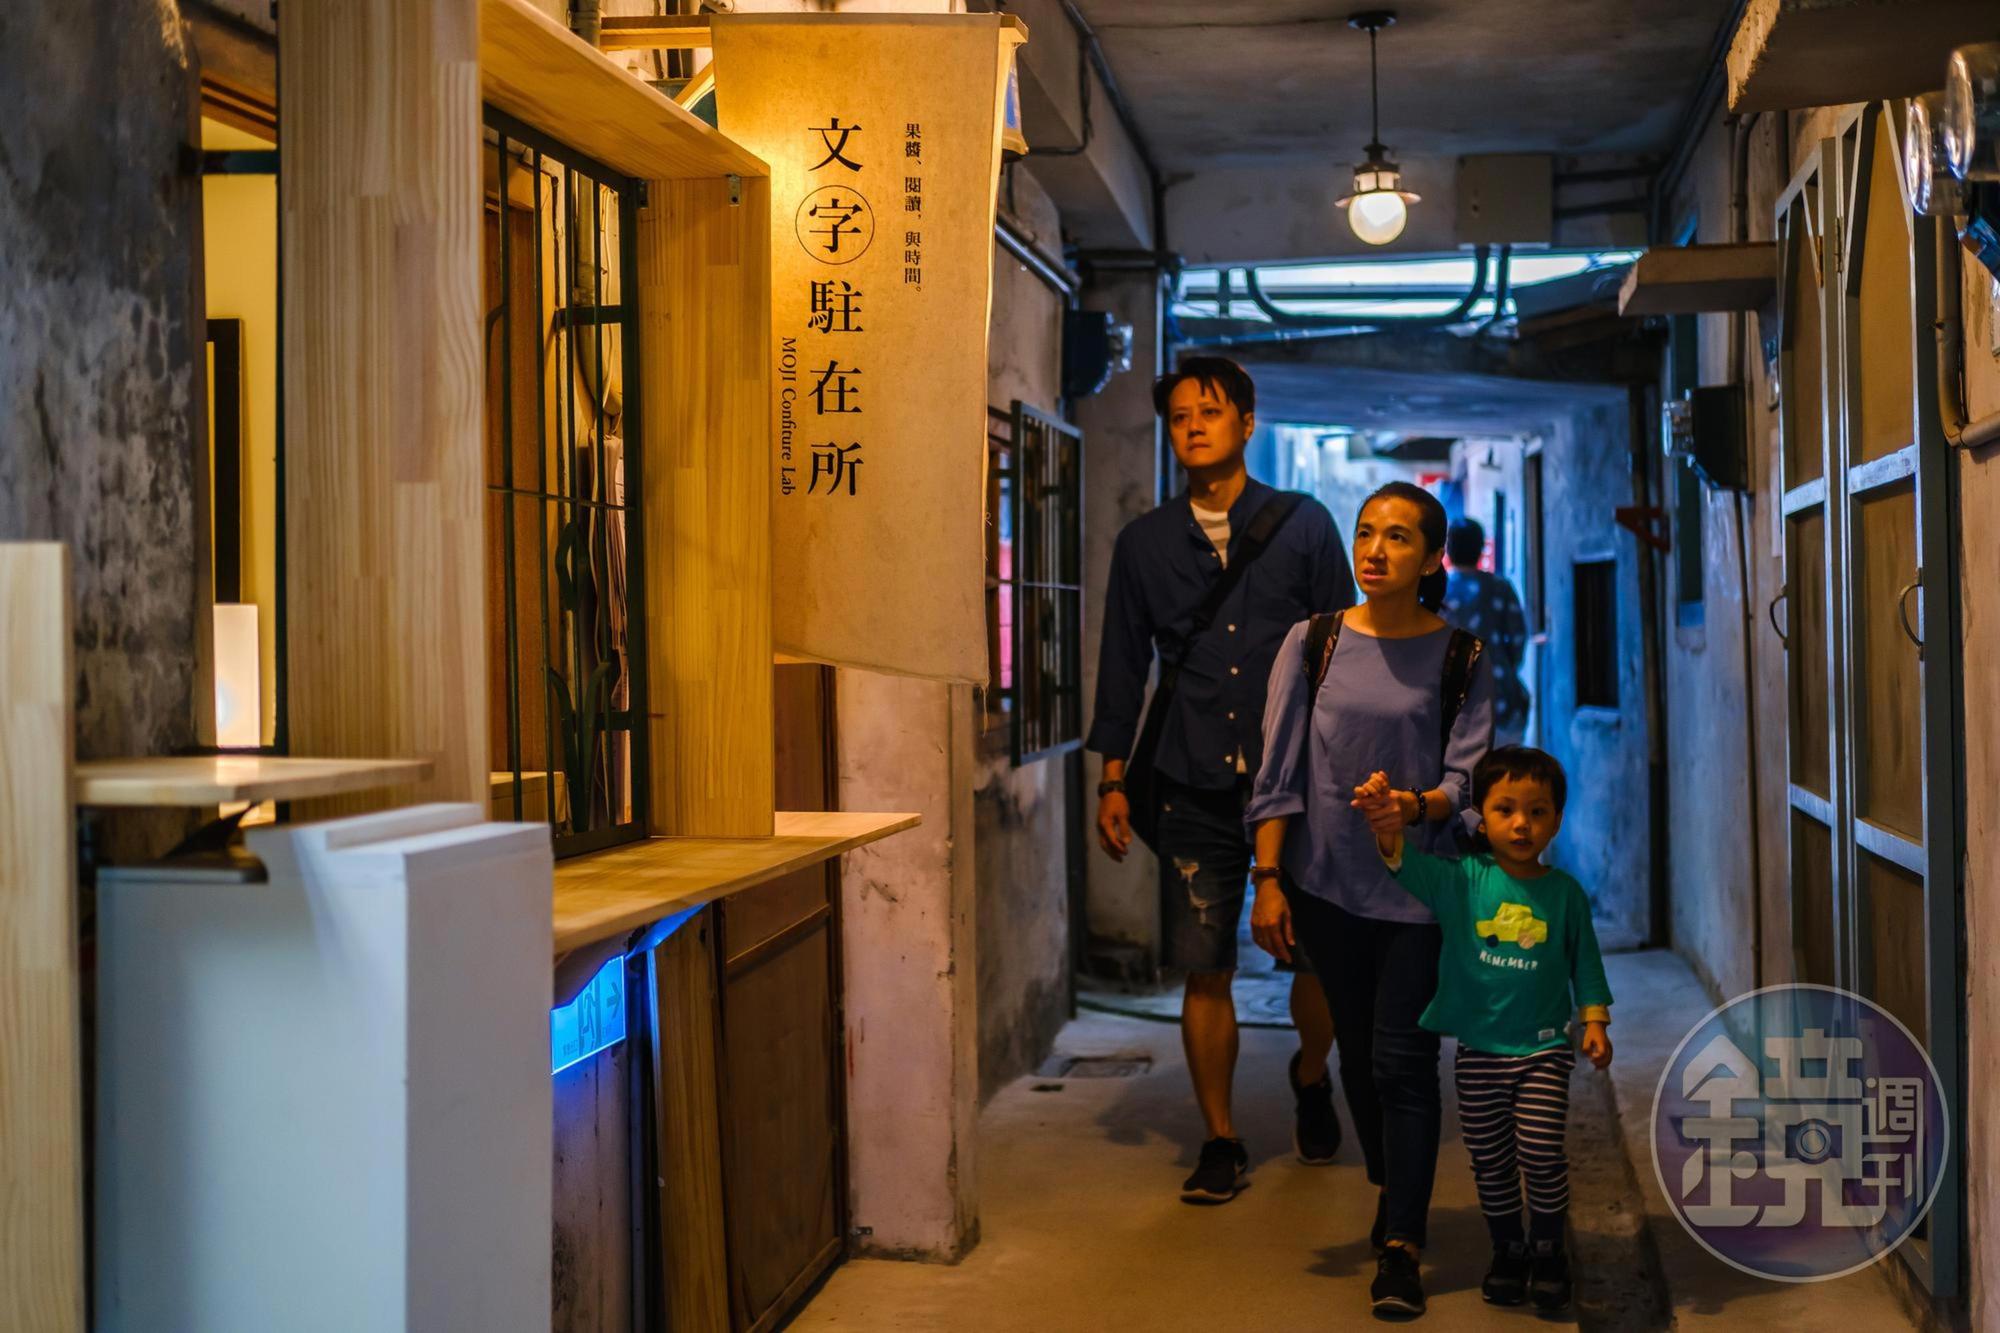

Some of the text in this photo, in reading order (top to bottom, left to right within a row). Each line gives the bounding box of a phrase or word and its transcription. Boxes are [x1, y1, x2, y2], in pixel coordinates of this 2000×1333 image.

[778, 336, 798, 496] MOJI Confiture Lab
[807, 117, 865, 497] 文字駐在所
